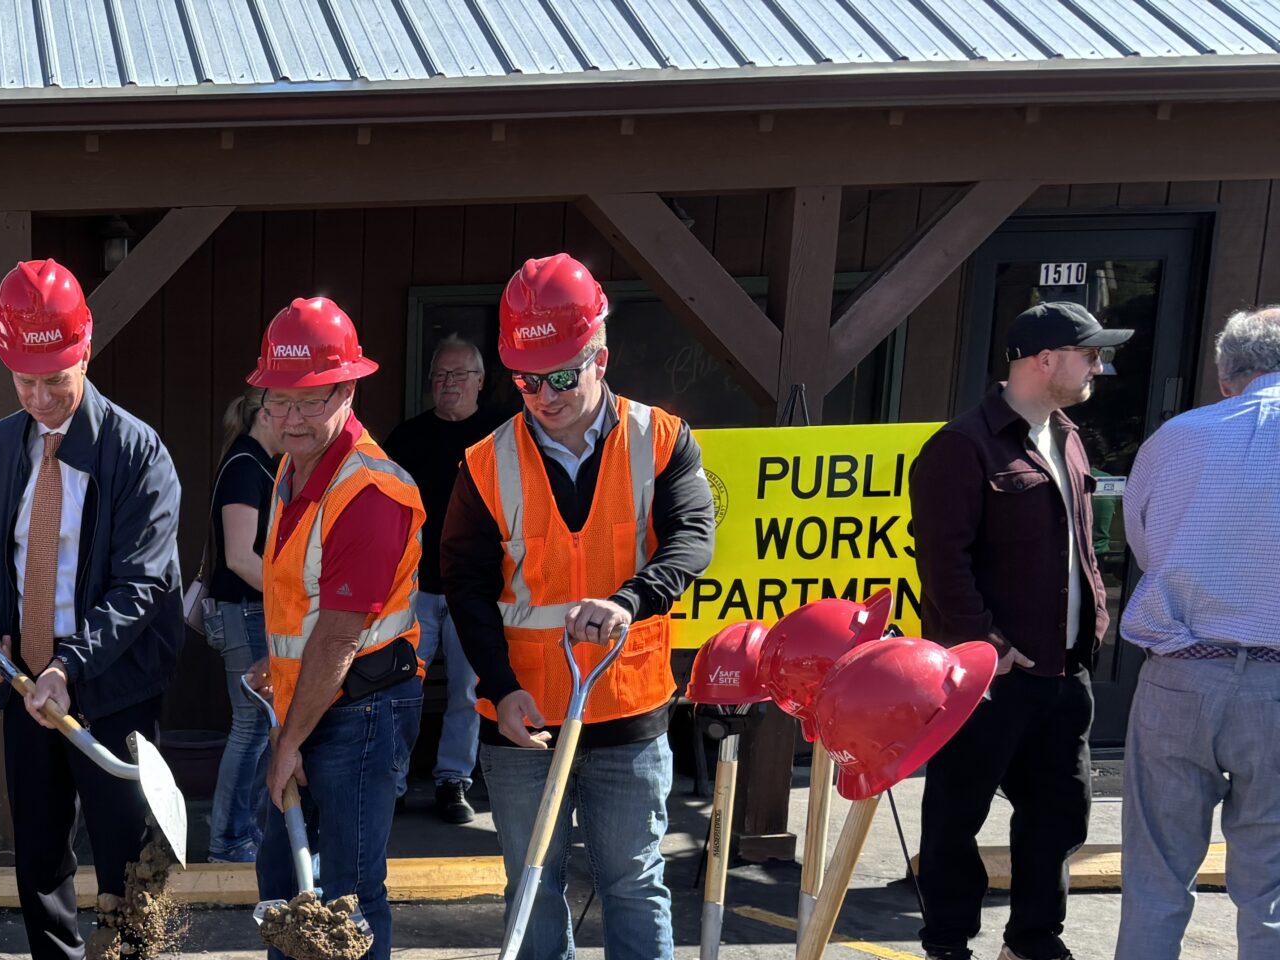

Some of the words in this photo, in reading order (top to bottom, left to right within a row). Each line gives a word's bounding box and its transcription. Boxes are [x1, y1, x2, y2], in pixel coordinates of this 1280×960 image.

[1043, 264, 1085, 284] 1510
[22, 328, 63, 343] VRANA
[515, 322, 557, 339] VRANA
[272, 343, 311, 358] VRANA
[757, 453, 916, 500] PUBLI
[719, 670, 741, 678] SAFE
